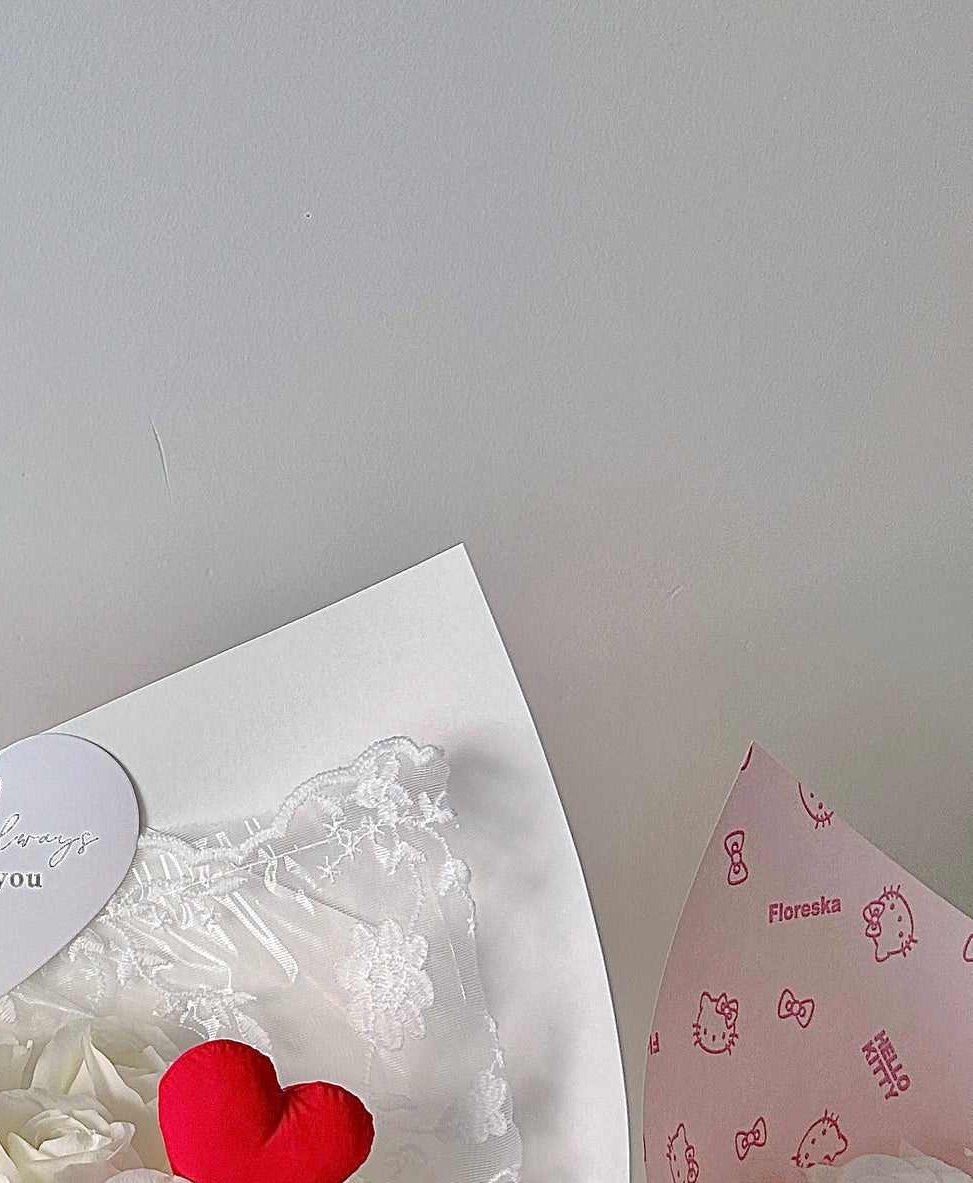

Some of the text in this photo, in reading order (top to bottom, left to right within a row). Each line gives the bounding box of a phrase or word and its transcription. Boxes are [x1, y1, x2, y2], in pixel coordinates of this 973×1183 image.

[768, 895, 842, 923] Floreska
[861, 1040, 898, 1100] KITTY
[874, 1029, 911, 1092] HELLO
